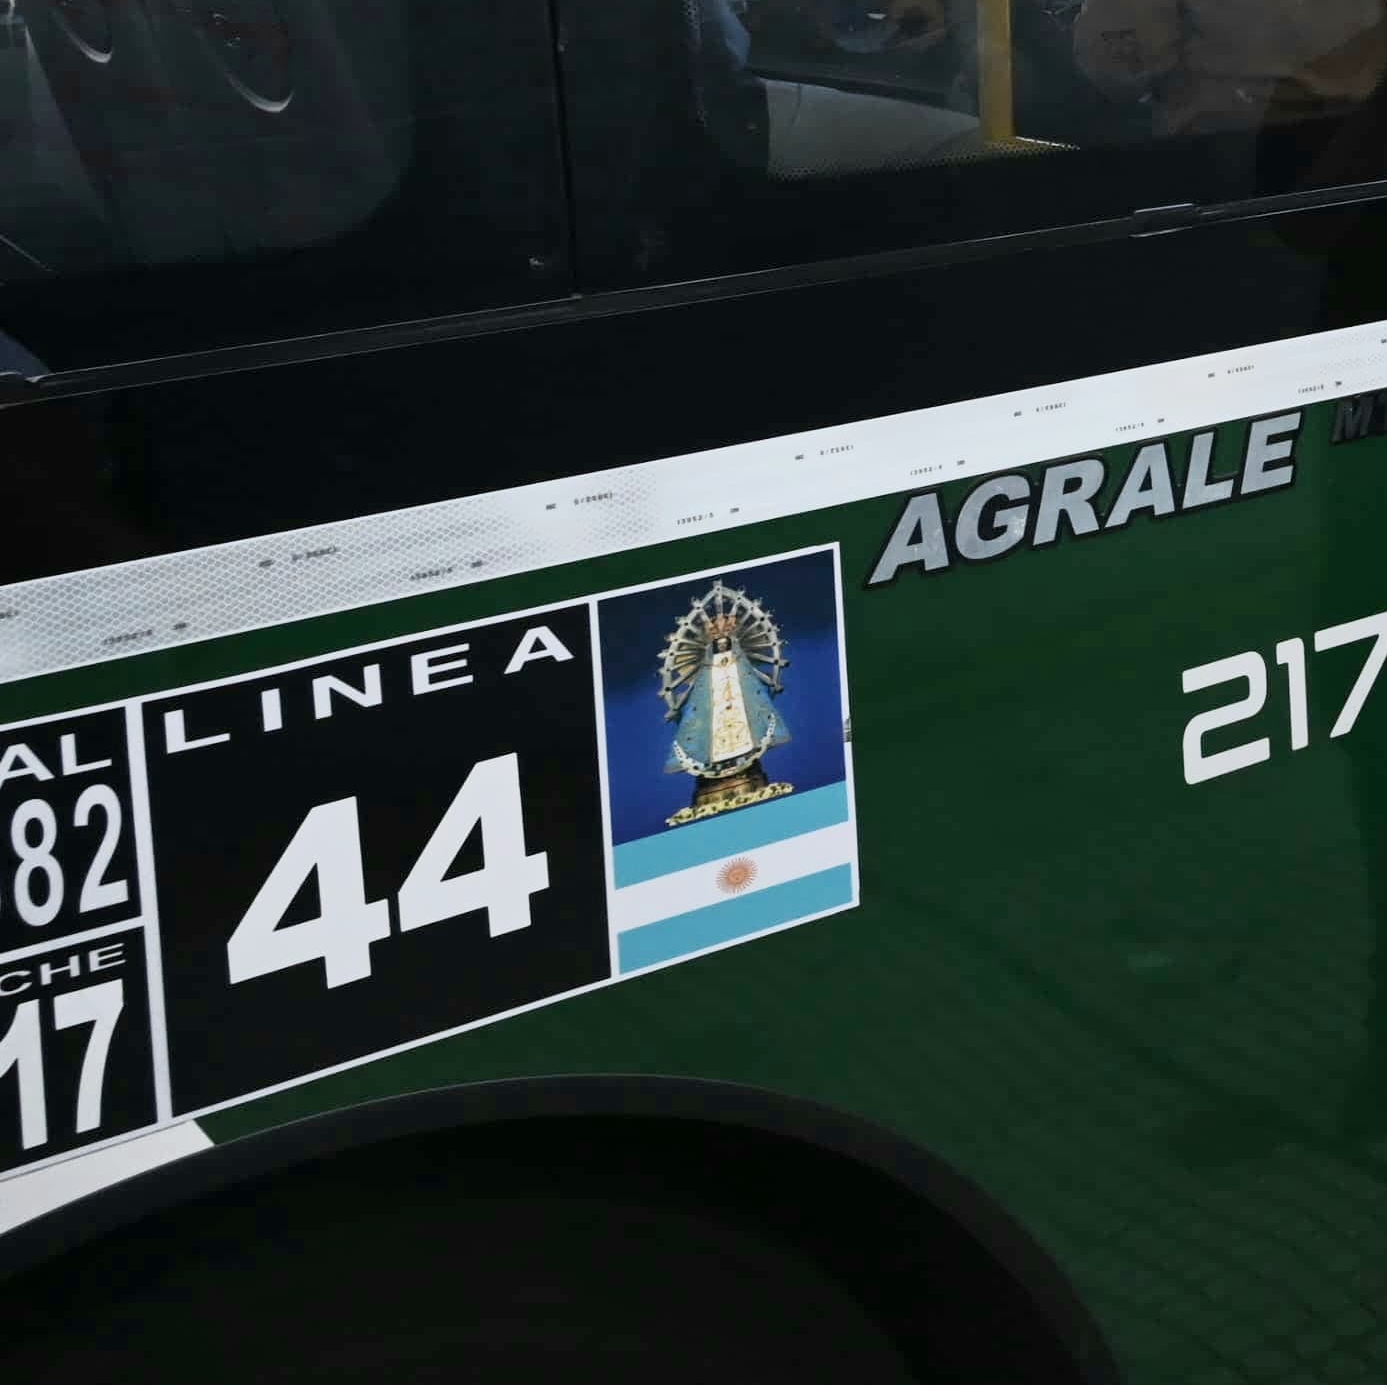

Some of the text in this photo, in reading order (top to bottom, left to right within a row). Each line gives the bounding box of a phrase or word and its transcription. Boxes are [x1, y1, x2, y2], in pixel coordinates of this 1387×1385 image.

[868, 411, 1302, 585] AGRALE
[164, 625, 575, 753] LINEA
[0, 733, 112, 789] AL
[11, 784, 129, 927] 82
[227, 751, 551, 990] 44
[0, 943, 126, 996] CHE
[0, 978, 124, 1150] 17
